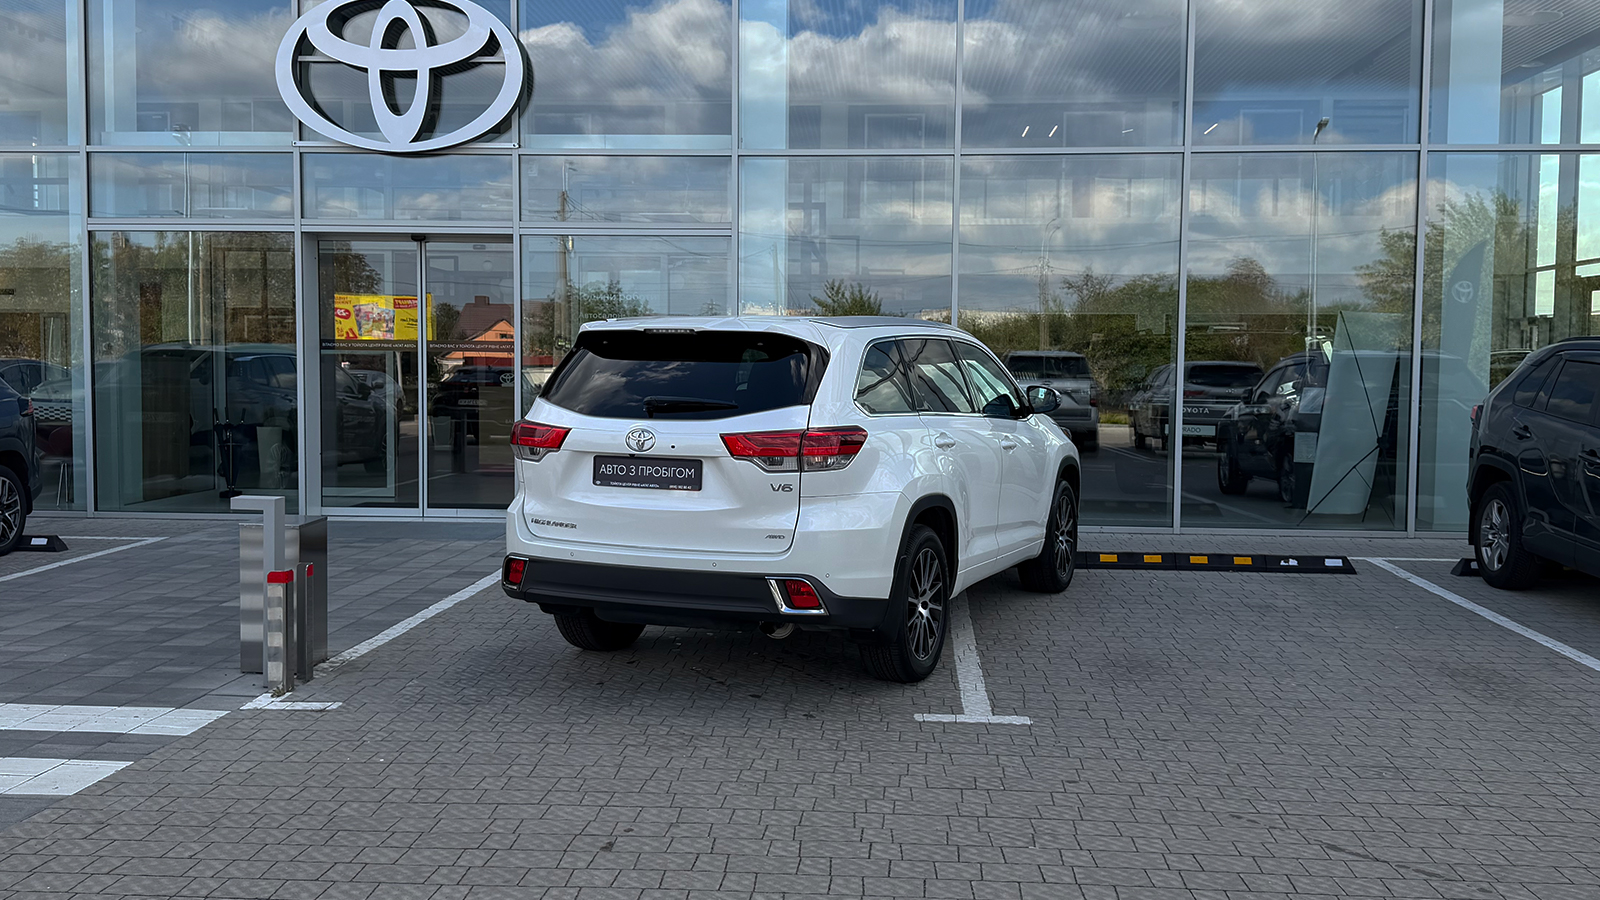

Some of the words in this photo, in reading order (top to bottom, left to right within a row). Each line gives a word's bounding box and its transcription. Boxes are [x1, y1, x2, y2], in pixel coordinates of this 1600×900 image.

[599, 464, 627, 475] АВТО
[638, 466, 695, 479] ПРОБІГОМ
[770, 483, 793, 492] V6
